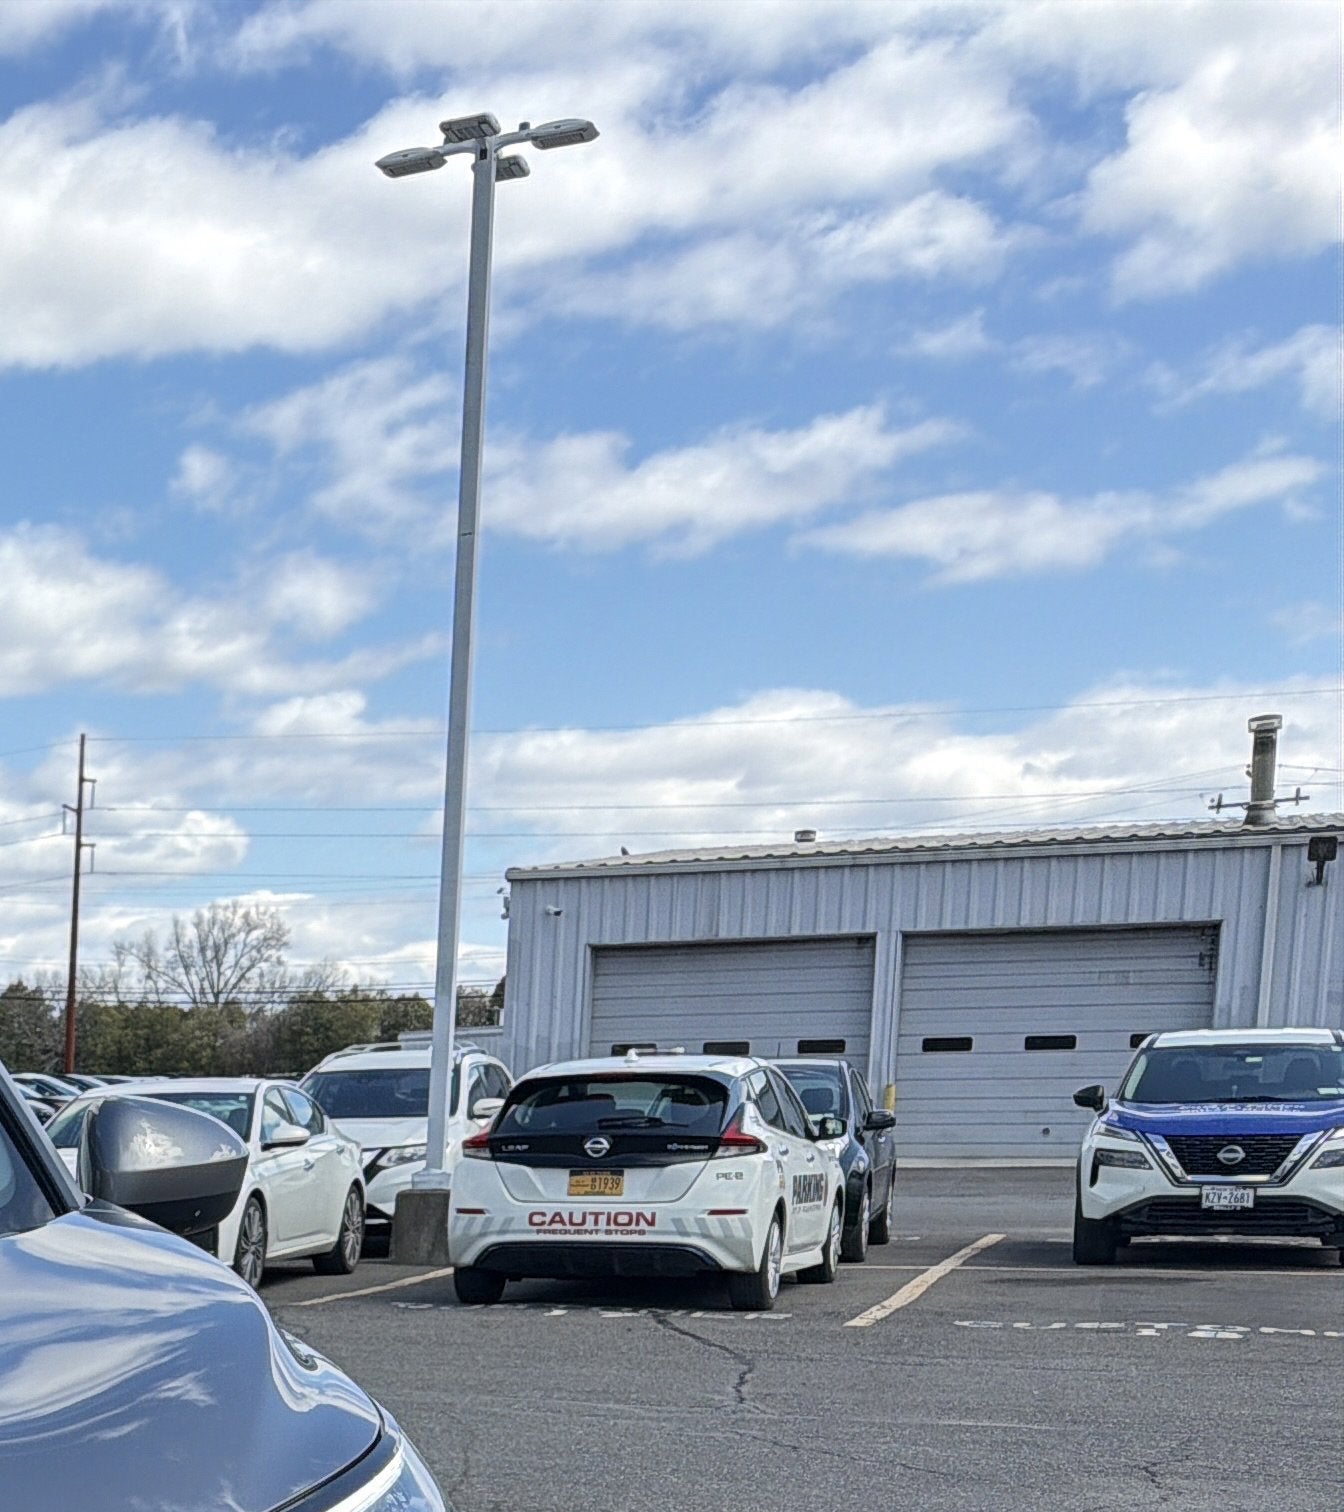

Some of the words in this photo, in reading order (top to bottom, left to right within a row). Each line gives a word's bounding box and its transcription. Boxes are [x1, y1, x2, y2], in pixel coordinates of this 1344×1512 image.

[527, 1211, 657, 1227] CAUTION
[535, 1228, 601, 1236] FREQUENT
[604, 1228, 647, 1236] STOPS
